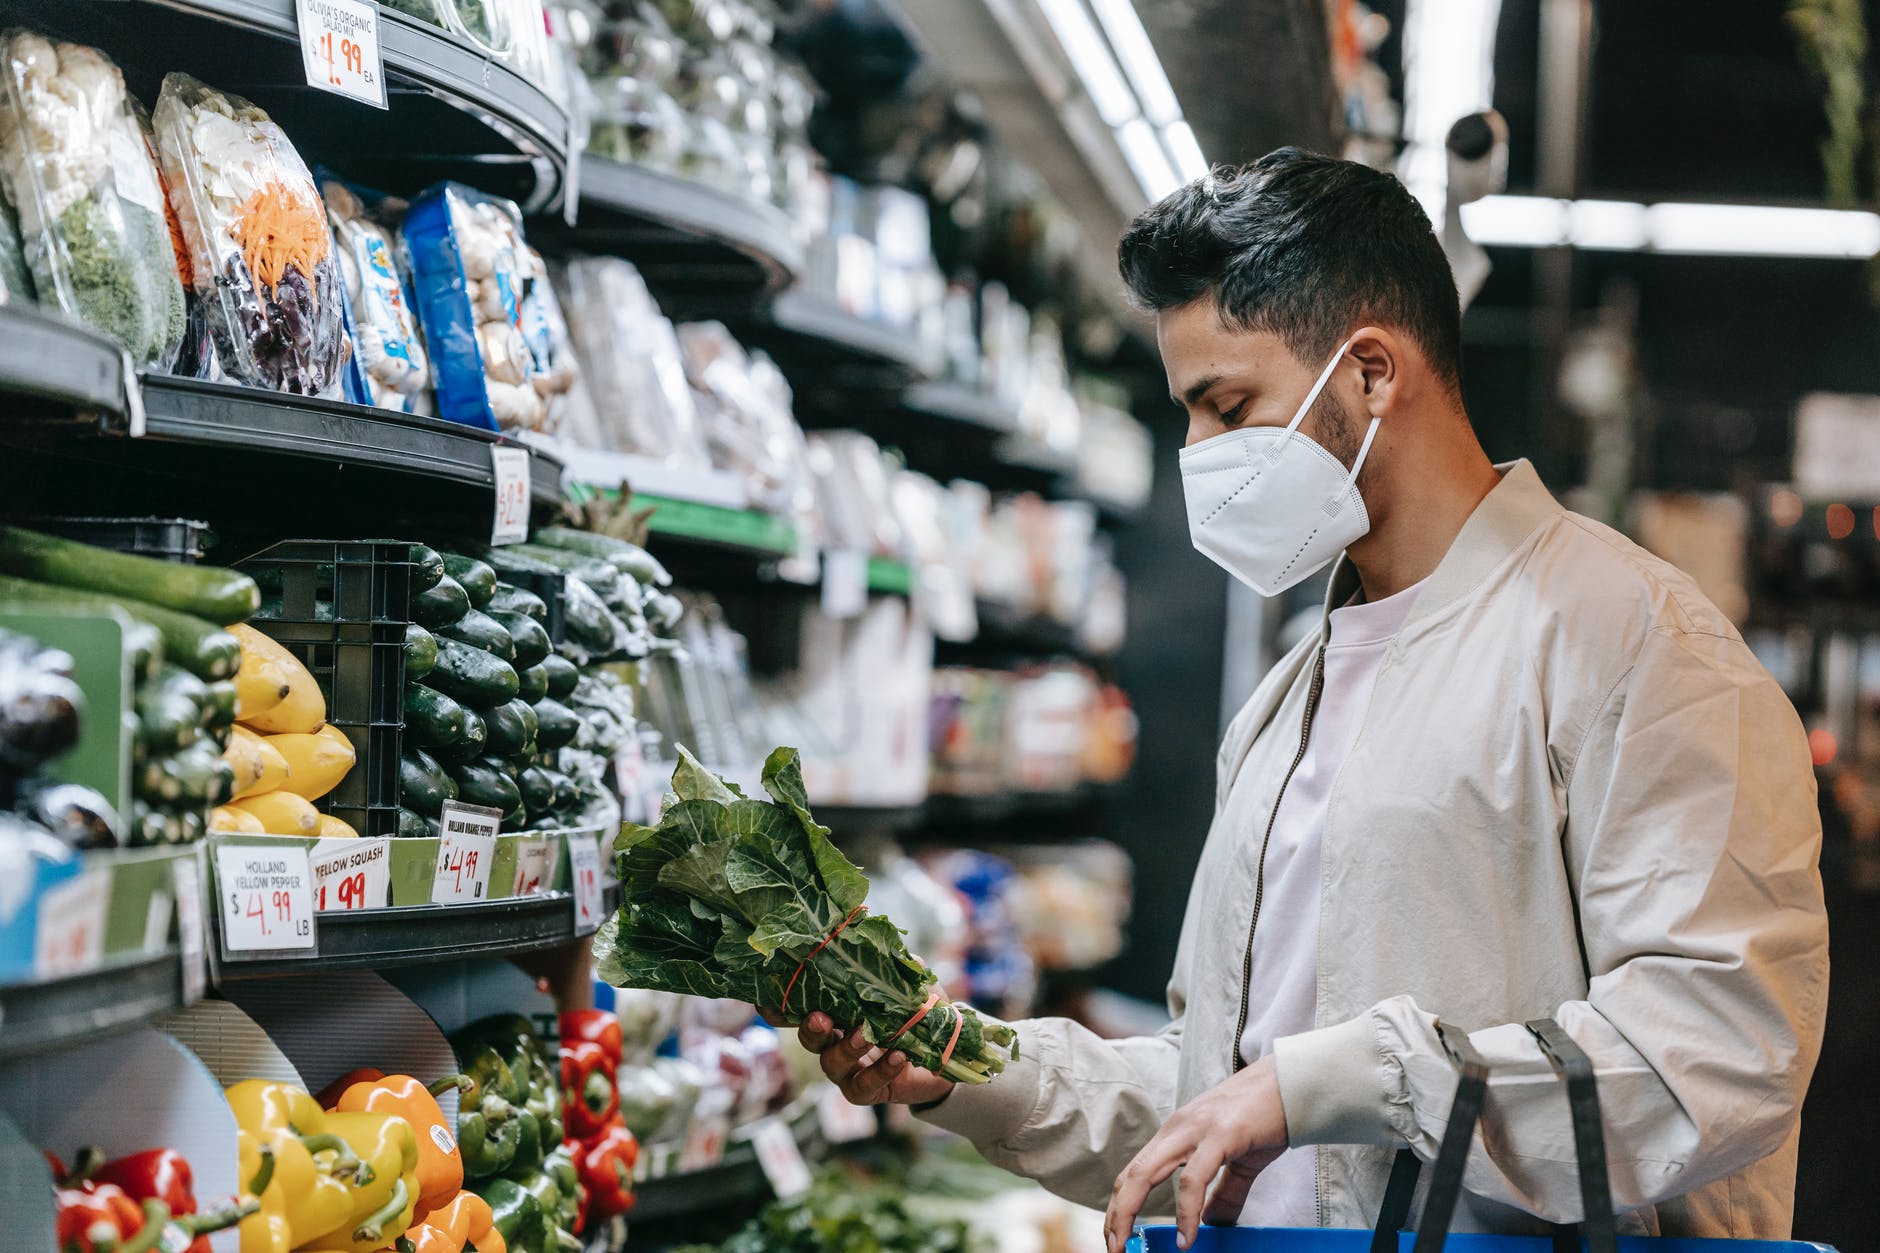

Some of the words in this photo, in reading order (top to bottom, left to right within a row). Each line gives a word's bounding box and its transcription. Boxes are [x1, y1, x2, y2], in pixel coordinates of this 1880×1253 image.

[322, 16, 342, 33] SALAD
[343, 25, 355, 38] MIX
[340, 10, 371, 33] ORGANIC
[364, 70, 374, 85] EA
[448, 820, 465, 833] HOLLAND
[465, 822, 480, 836] ORANGE
[480, 825, 493, 837] PEPPER
[245, 861, 287, 874] HOLLAND
[314, 857, 348, 878] YELLOW
[350, 845, 384, 868] SQUASH
[235, 876, 268, 889] YELLOW
[271, 876, 302, 889] PEPPER
[474, 881, 483, 898] LB
[296, 919, 310, 936] LB
